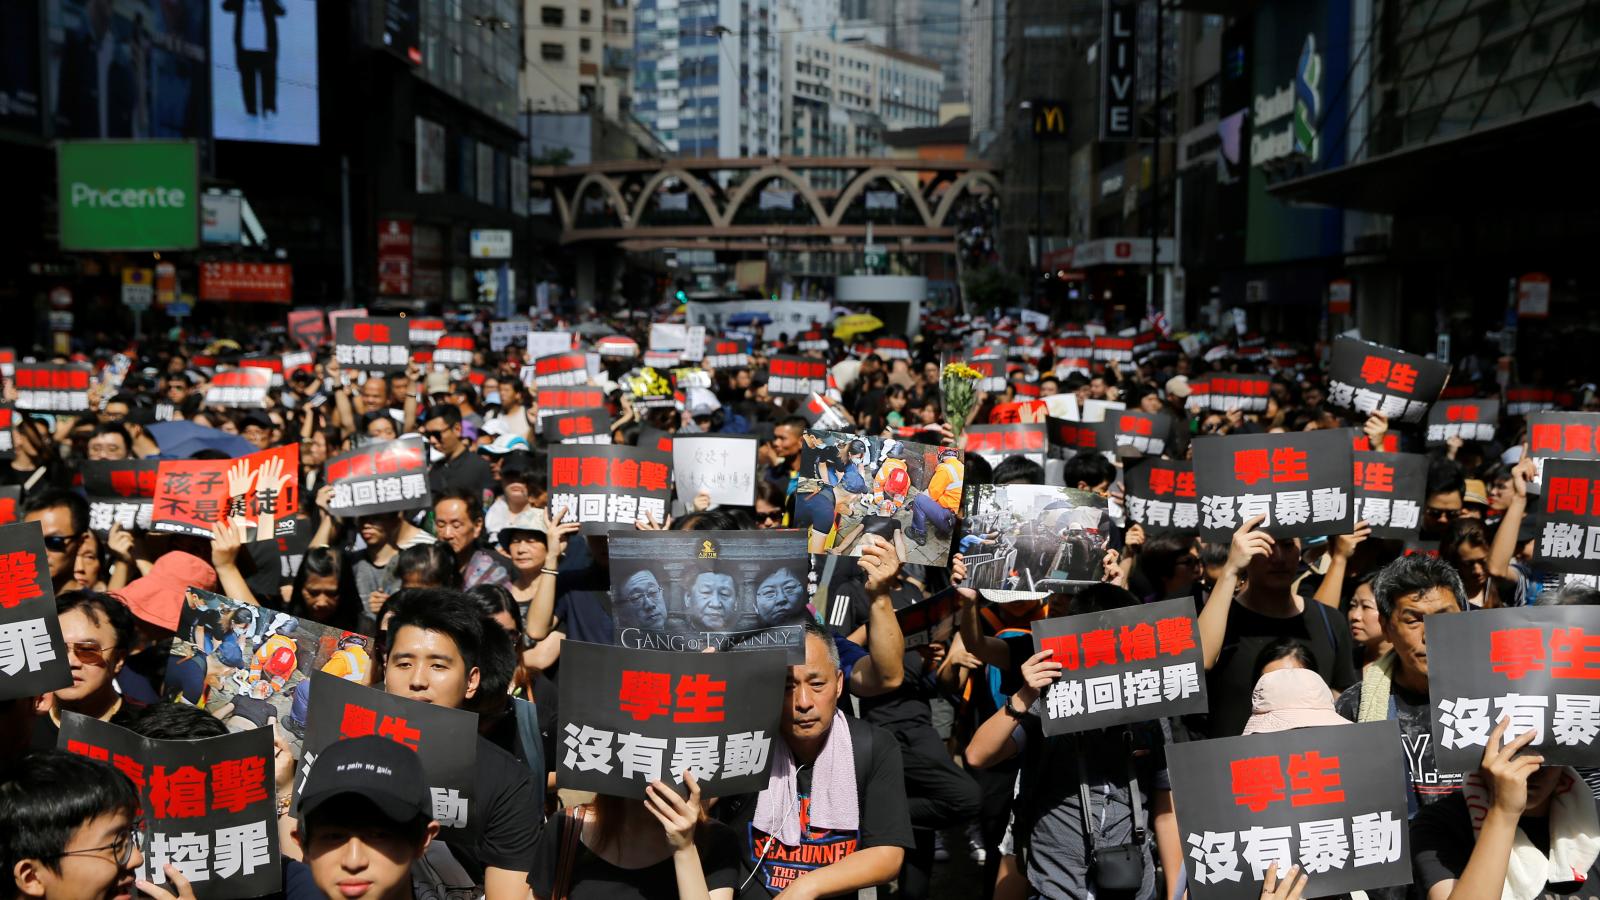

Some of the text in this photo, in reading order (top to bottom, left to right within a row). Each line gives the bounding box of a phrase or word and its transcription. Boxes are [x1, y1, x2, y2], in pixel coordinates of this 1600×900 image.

[1112, 11, 1131, 132] LIVE
[1359, 355, 1419, 394] 學生
[163, 471, 224, 496] 孩子
[551, 456, 669, 492] 問責槍擊
[1149, 467, 1196, 498] 學生
[1233, 446, 1310, 486] 學生
[551, 493, 666, 524] 撤回控罪
[1201, 486, 1348, 530] 沒有暴動
[1354, 497, 1421, 530] 暴動
[0, 617, 57, 677] 罪
[620, 628, 685, 651] GANG
[700, 631, 791, 650] TYRANNY
[1040, 615, 1197, 672] 問責槍擊
[1490, 627, 1600, 681] 學生
[619, 669, 727, 724] 學生
[1046, 661, 1200, 720] 撤回控罪
[563, 722, 772, 786] 沒有暴動
[1229, 750, 1346, 813] 學生
[1186, 810, 1402, 885] 沒有暴動
[773, 866, 796, 879] THE
